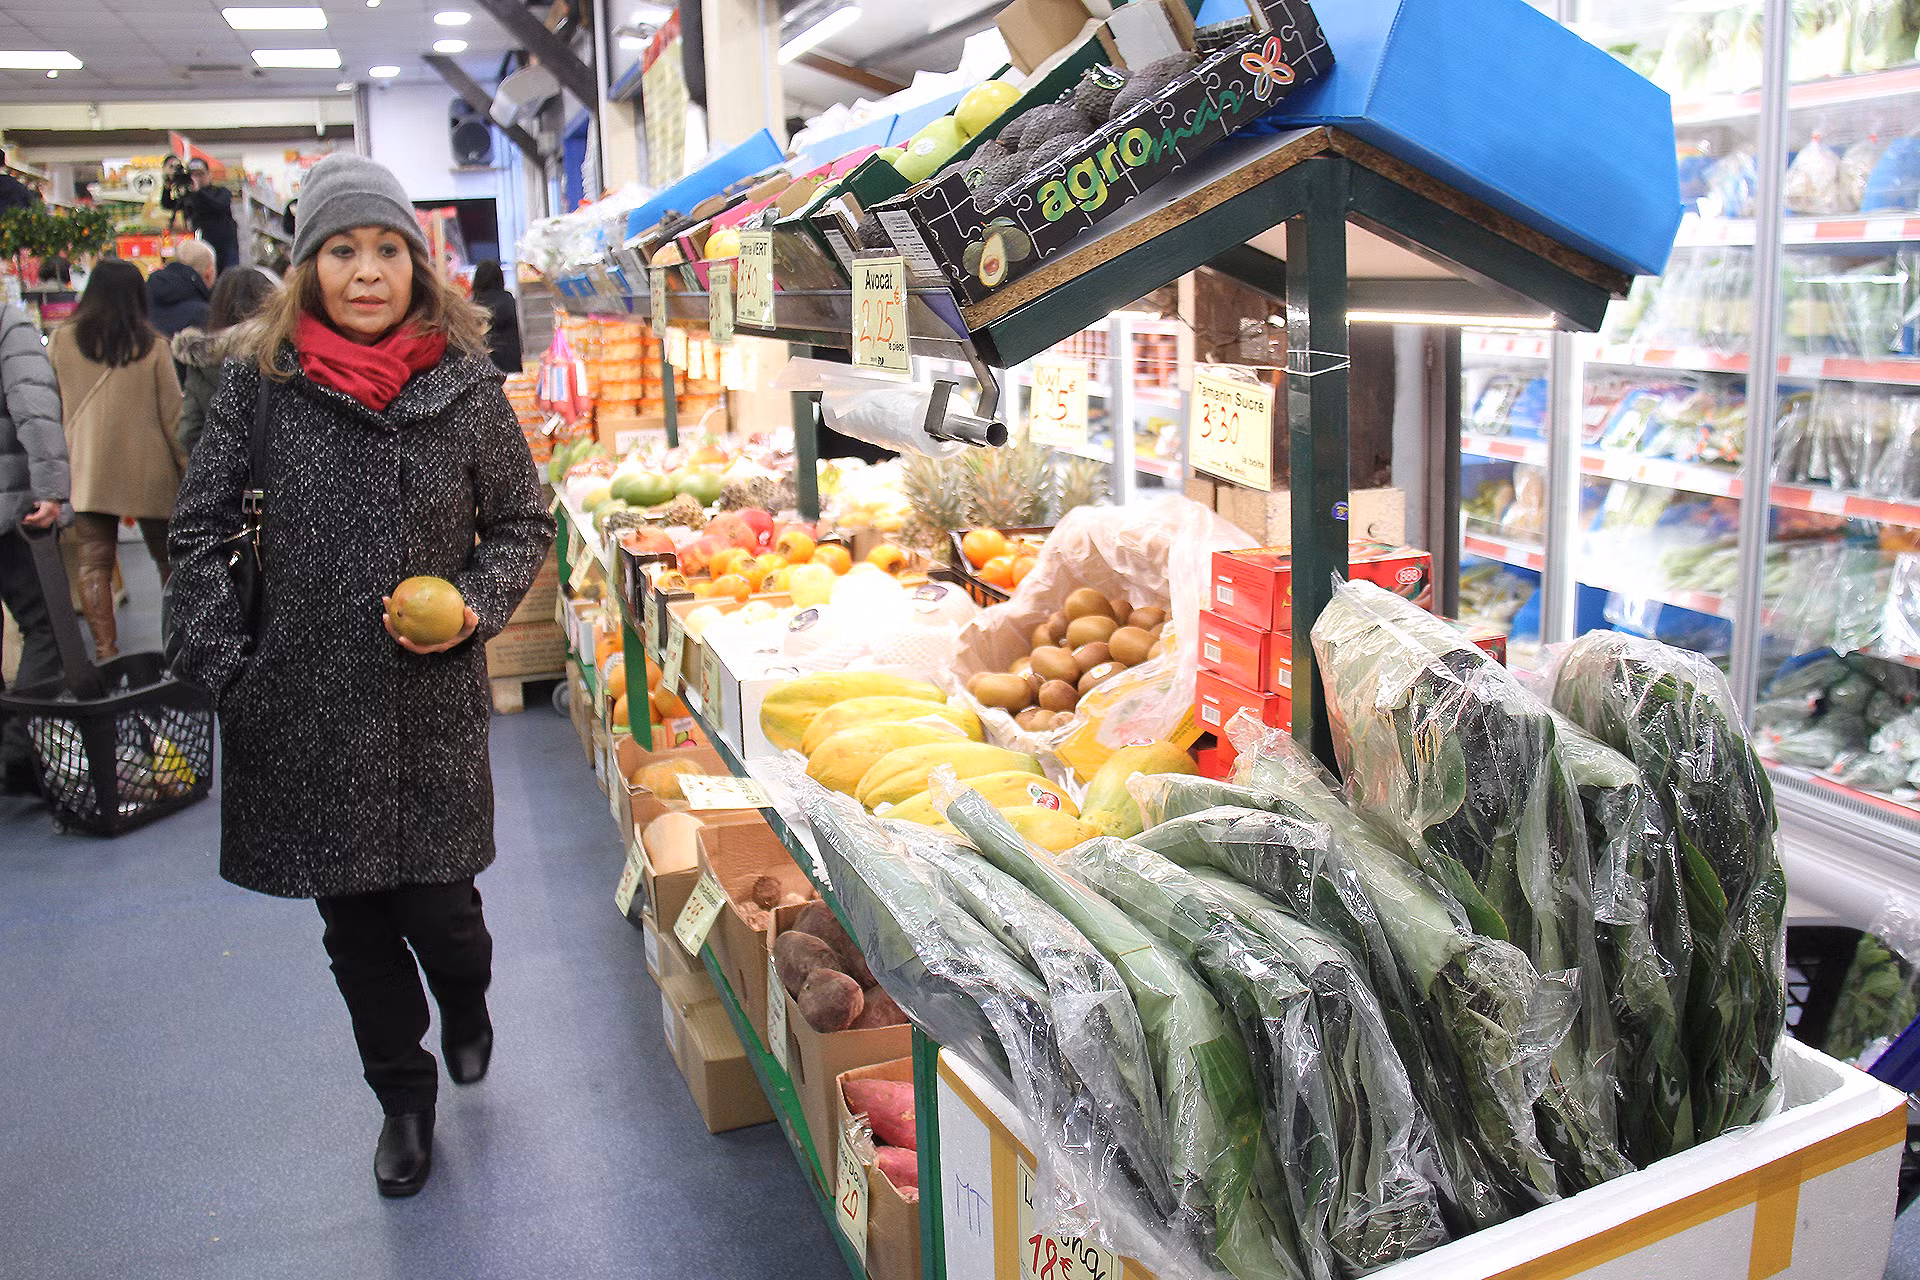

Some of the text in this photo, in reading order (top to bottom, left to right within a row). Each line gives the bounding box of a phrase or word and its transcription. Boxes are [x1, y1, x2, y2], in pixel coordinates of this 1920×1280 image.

[865, 269, 893, 290] Avocat
[1198, 380, 1264, 413] Tamarin Sucré
